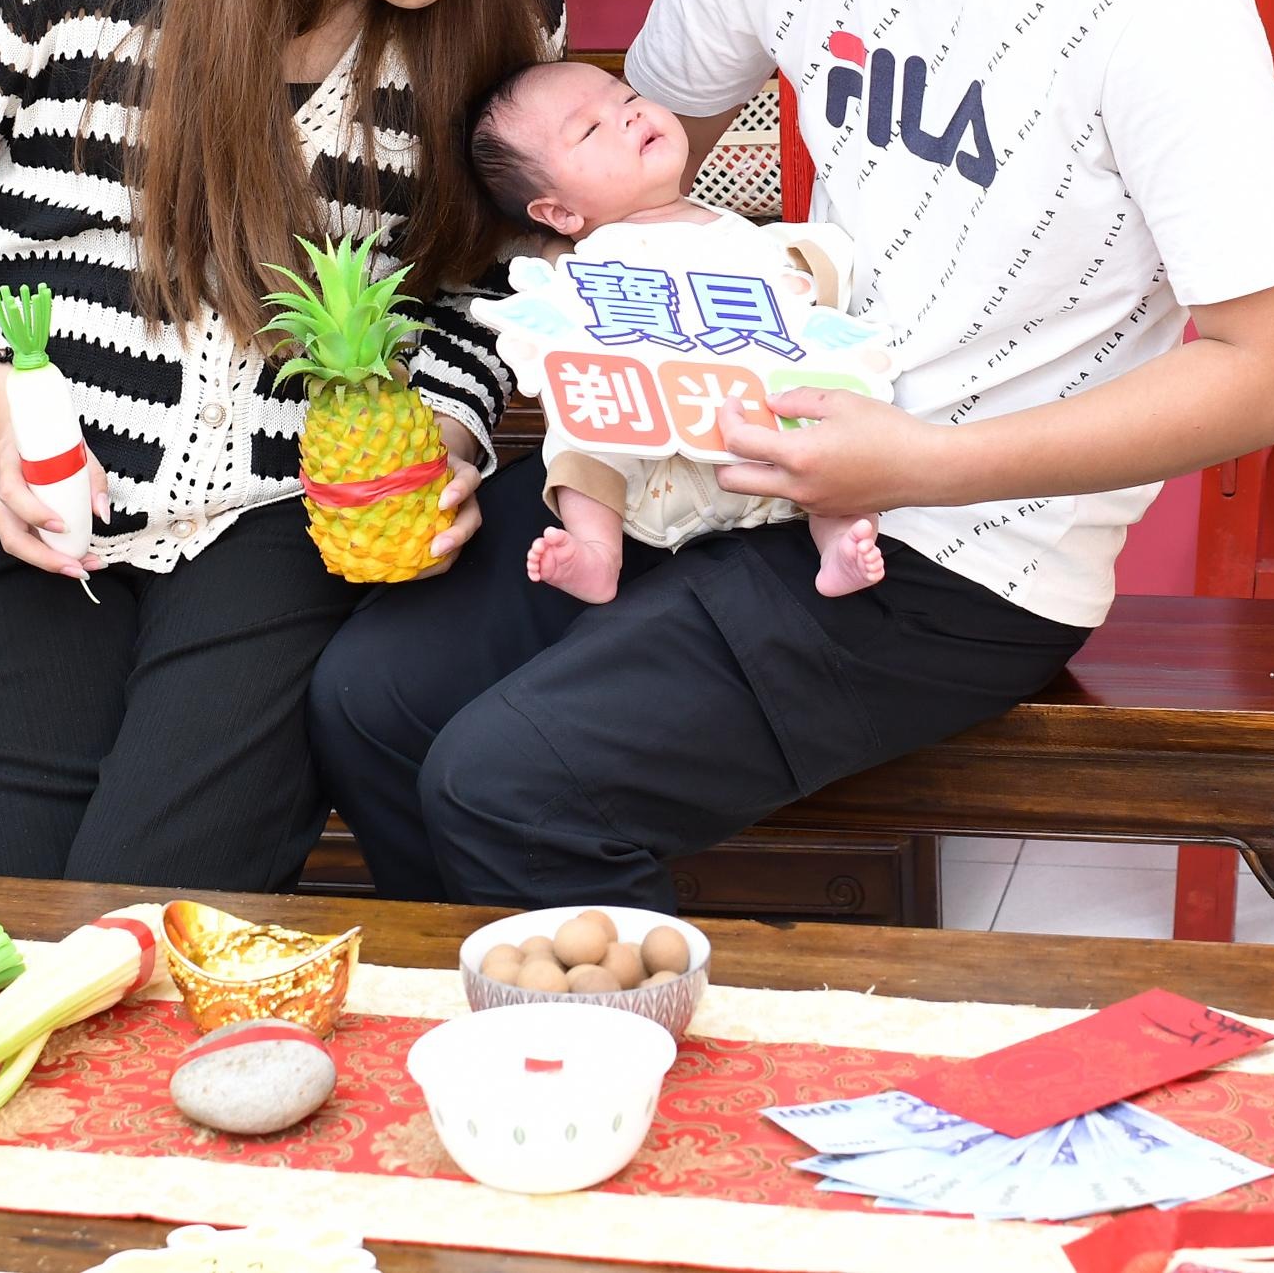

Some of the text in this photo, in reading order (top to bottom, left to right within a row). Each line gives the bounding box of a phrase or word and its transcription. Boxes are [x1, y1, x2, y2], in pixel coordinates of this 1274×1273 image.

[776, 11, 794, 41] FILA
[872, 6, 901, 39] FILA
[987, 41, 1011, 72] FILA
[1015, 2, 1045, 34] FILA
[1061, 25, 1089, 59] FILA
[930, 43, 950, 74] FILA
[826, 30, 997, 189] FILA
[1018, 109, 1041, 141] FILA
[832, 124, 854, 156] FILA
[884, 228, 912, 260] FILA
[914, 191, 932, 221] FILA
[983, 285, 1008, 315] FILA
[1008, 248, 1031, 278] FILA
[1032, 210, 1055, 239] FILA
[1055, 163, 1073, 199] FILA
[1070, 123, 1094, 152] FILA
[940, 258, 957, 288] FILA
[955, 224, 969, 253] FILA
[567, 261, 807, 362] 寶貝
[987, 339, 1018, 368] FILA
[1080, 257, 1104, 286] FILA
[1104, 212, 1126, 247] FILA
[1059, 370, 1088, 398] FILA
[1095, 331, 1124, 363] FILA
[950, 394, 981, 425] FILA
[935, 538, 965, 563] FILA
[973, 515, 1011, 536] FILA
